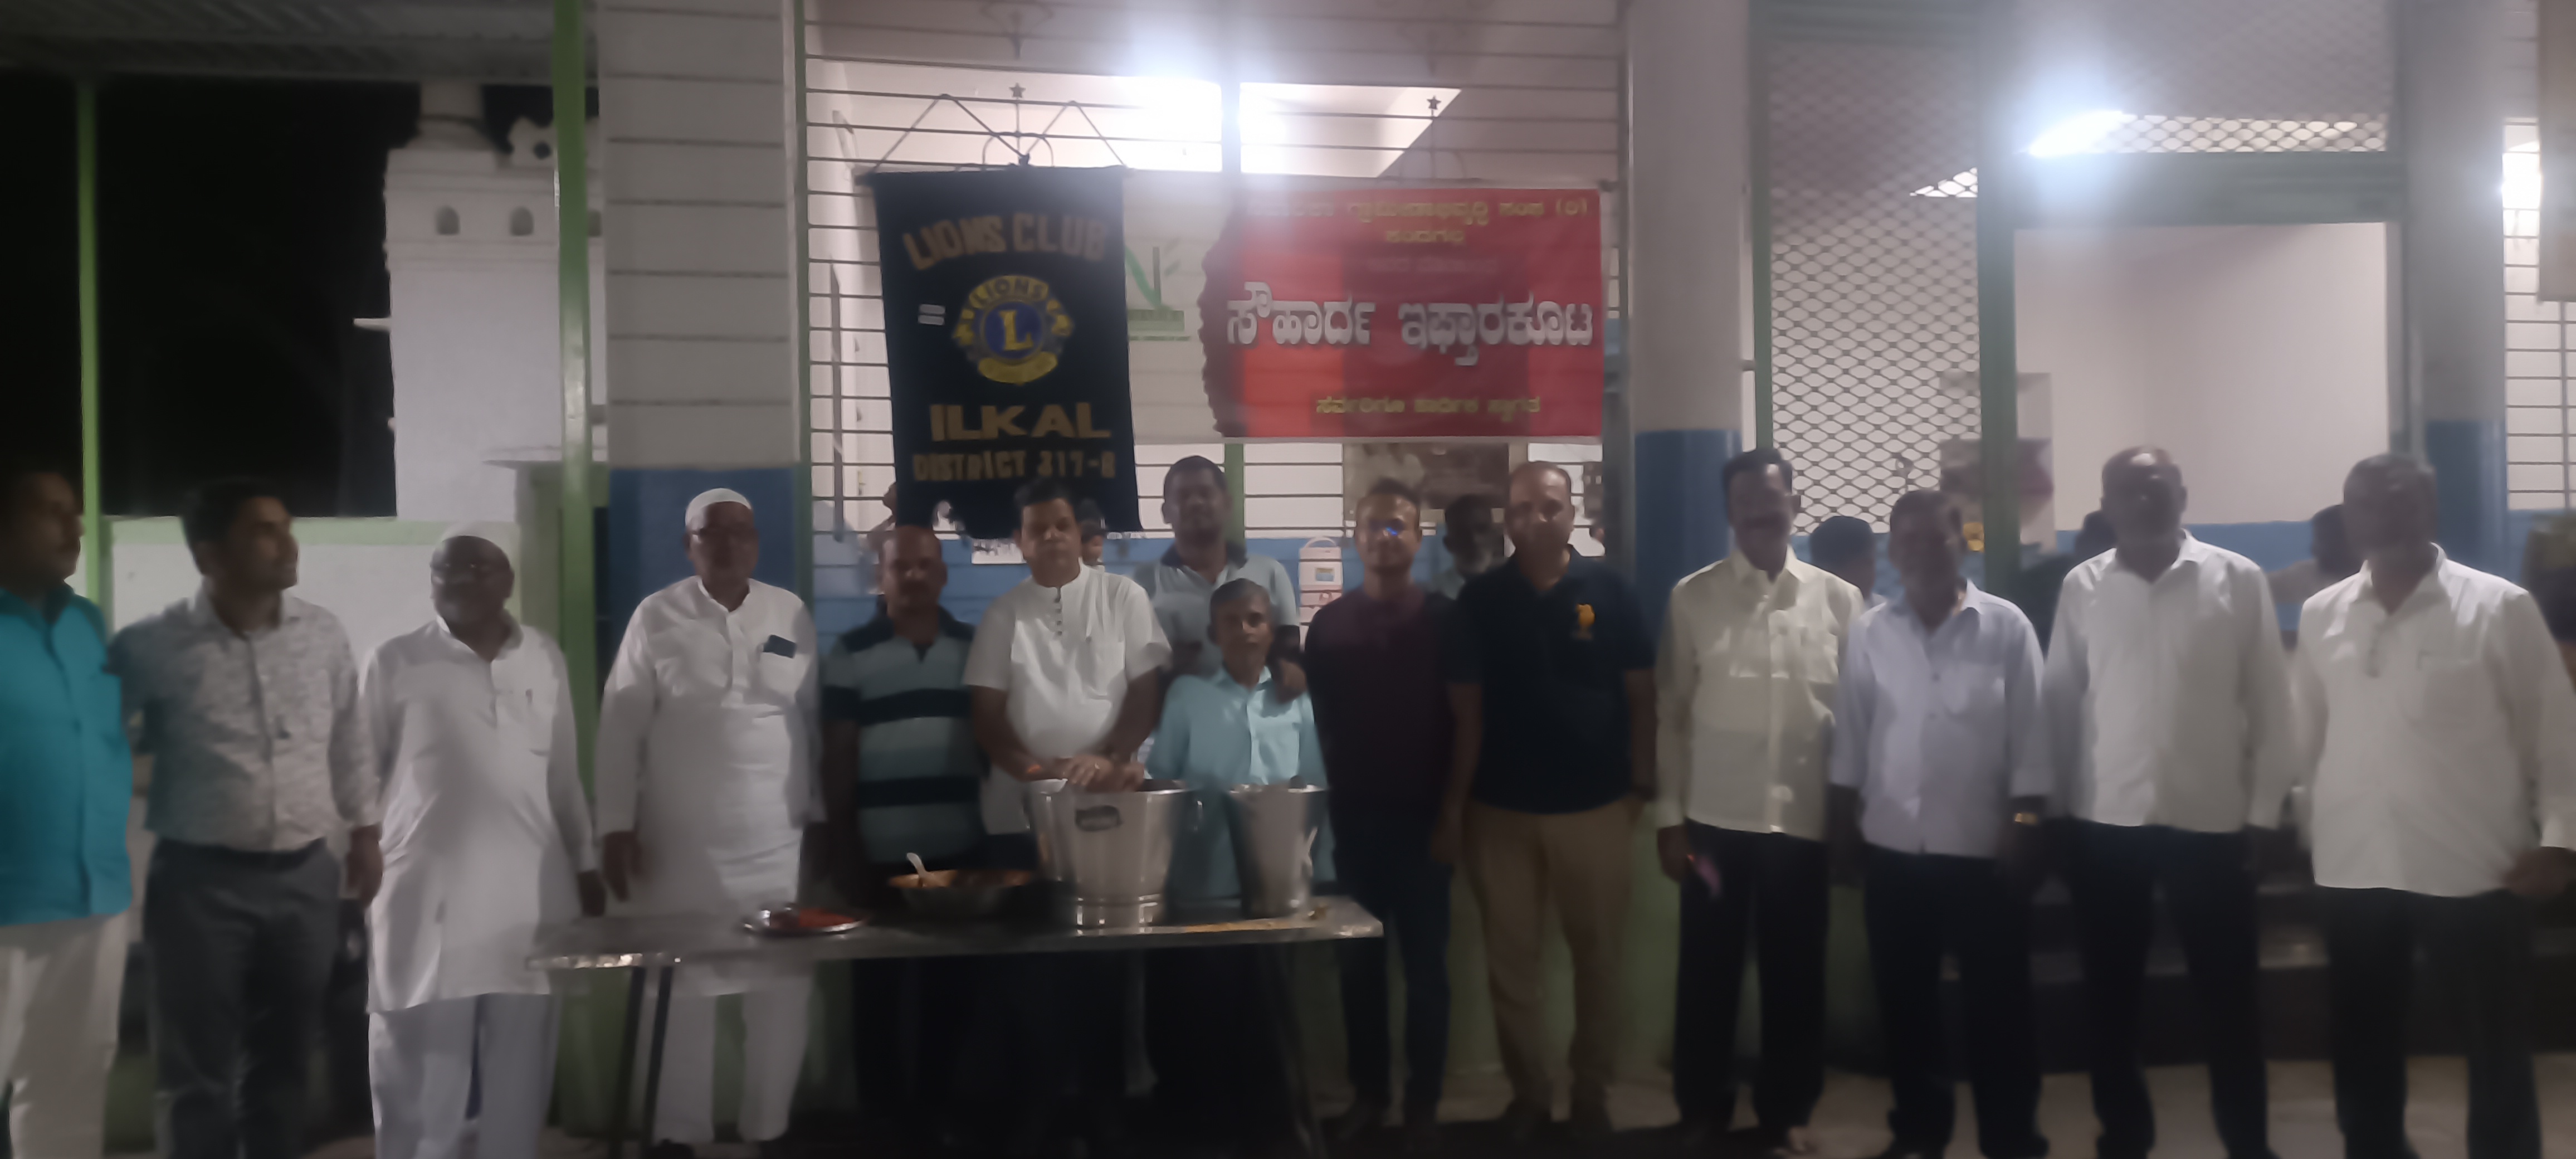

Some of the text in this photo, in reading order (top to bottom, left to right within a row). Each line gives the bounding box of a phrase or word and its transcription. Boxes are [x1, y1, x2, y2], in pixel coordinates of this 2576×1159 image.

[902, 213, 1105, 270] LIONS CLUB
[970, 277, 1045, 306] LIONS
[998, 308, 1034, 351] L
[1226, 281, 1376, 345] ಸೌಹಾರ್ದ
[930, 402, 1111, 442] ILKAL
[913, 450, 1026, 481] DISTRICT
